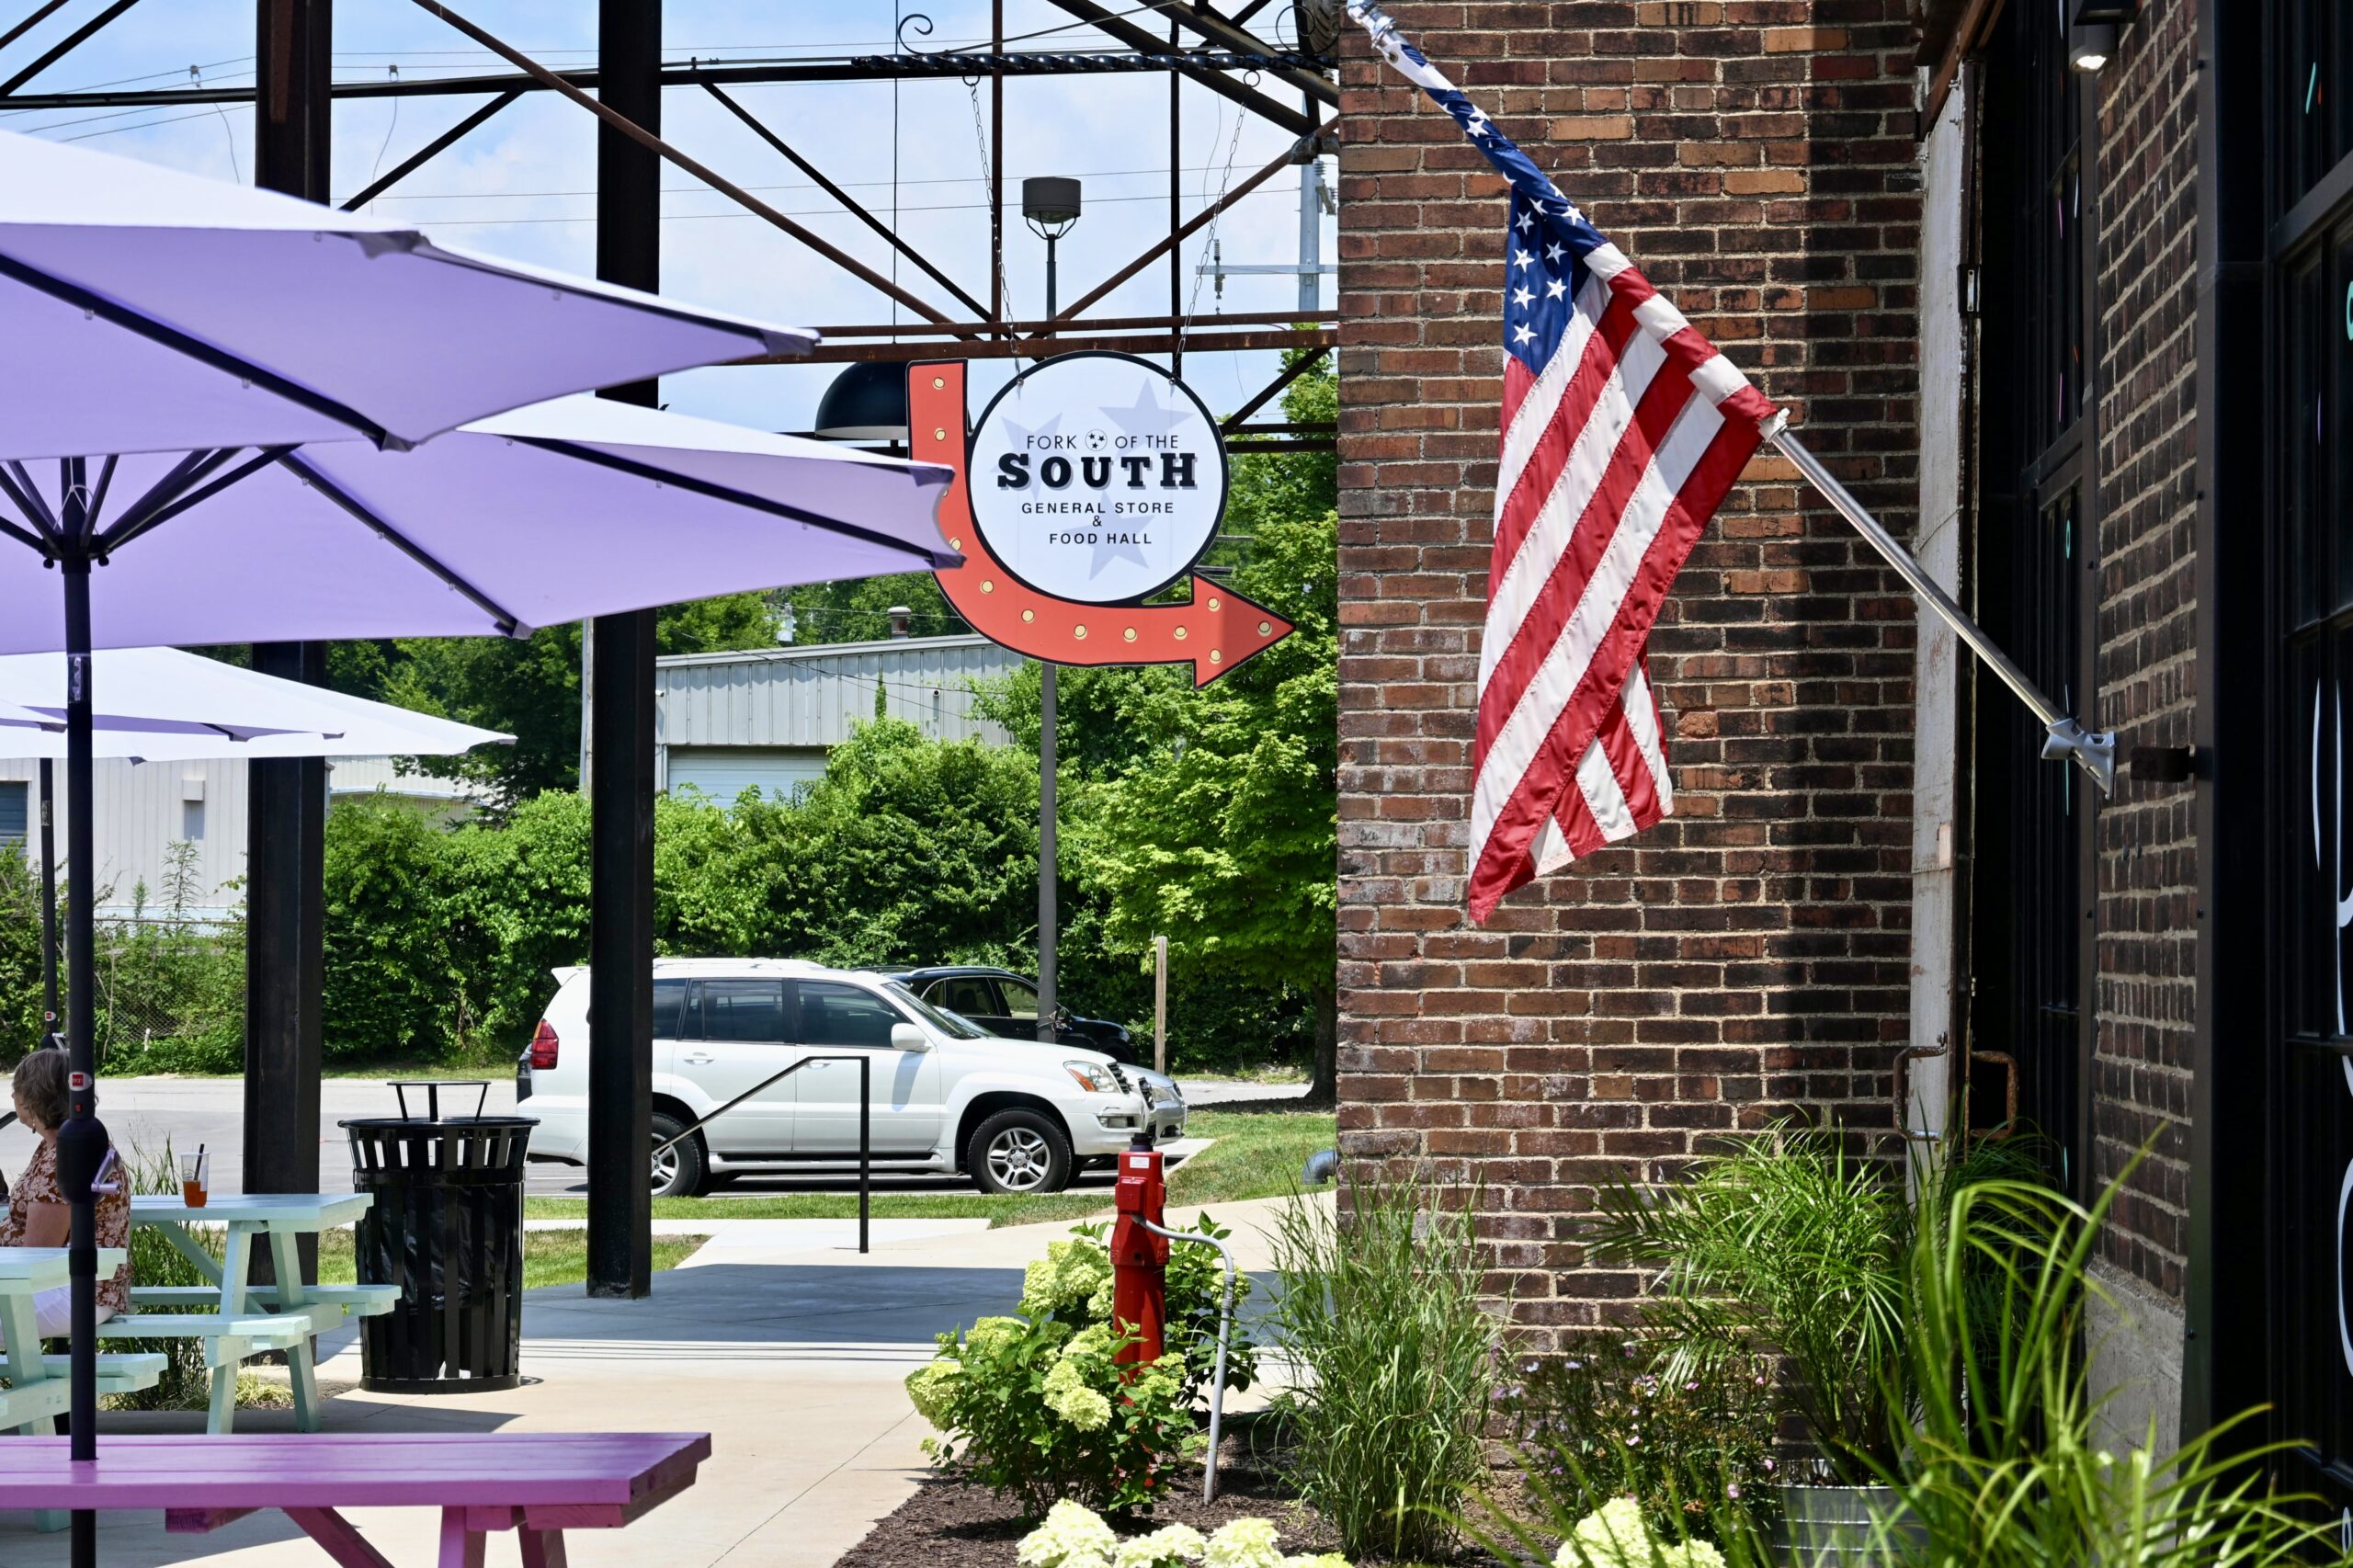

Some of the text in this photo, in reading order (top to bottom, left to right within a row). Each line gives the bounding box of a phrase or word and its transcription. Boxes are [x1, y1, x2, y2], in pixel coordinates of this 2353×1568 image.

[1027, 435, 1178, 449] FORK OF THE
[997, 452, 1197, 489] SOUTH
[1021, 502, 1174, 515] GENERAL STORE
[1092, 515, 1103, 528] &
[1049, 532, 1152, 545] FOOD HALL
